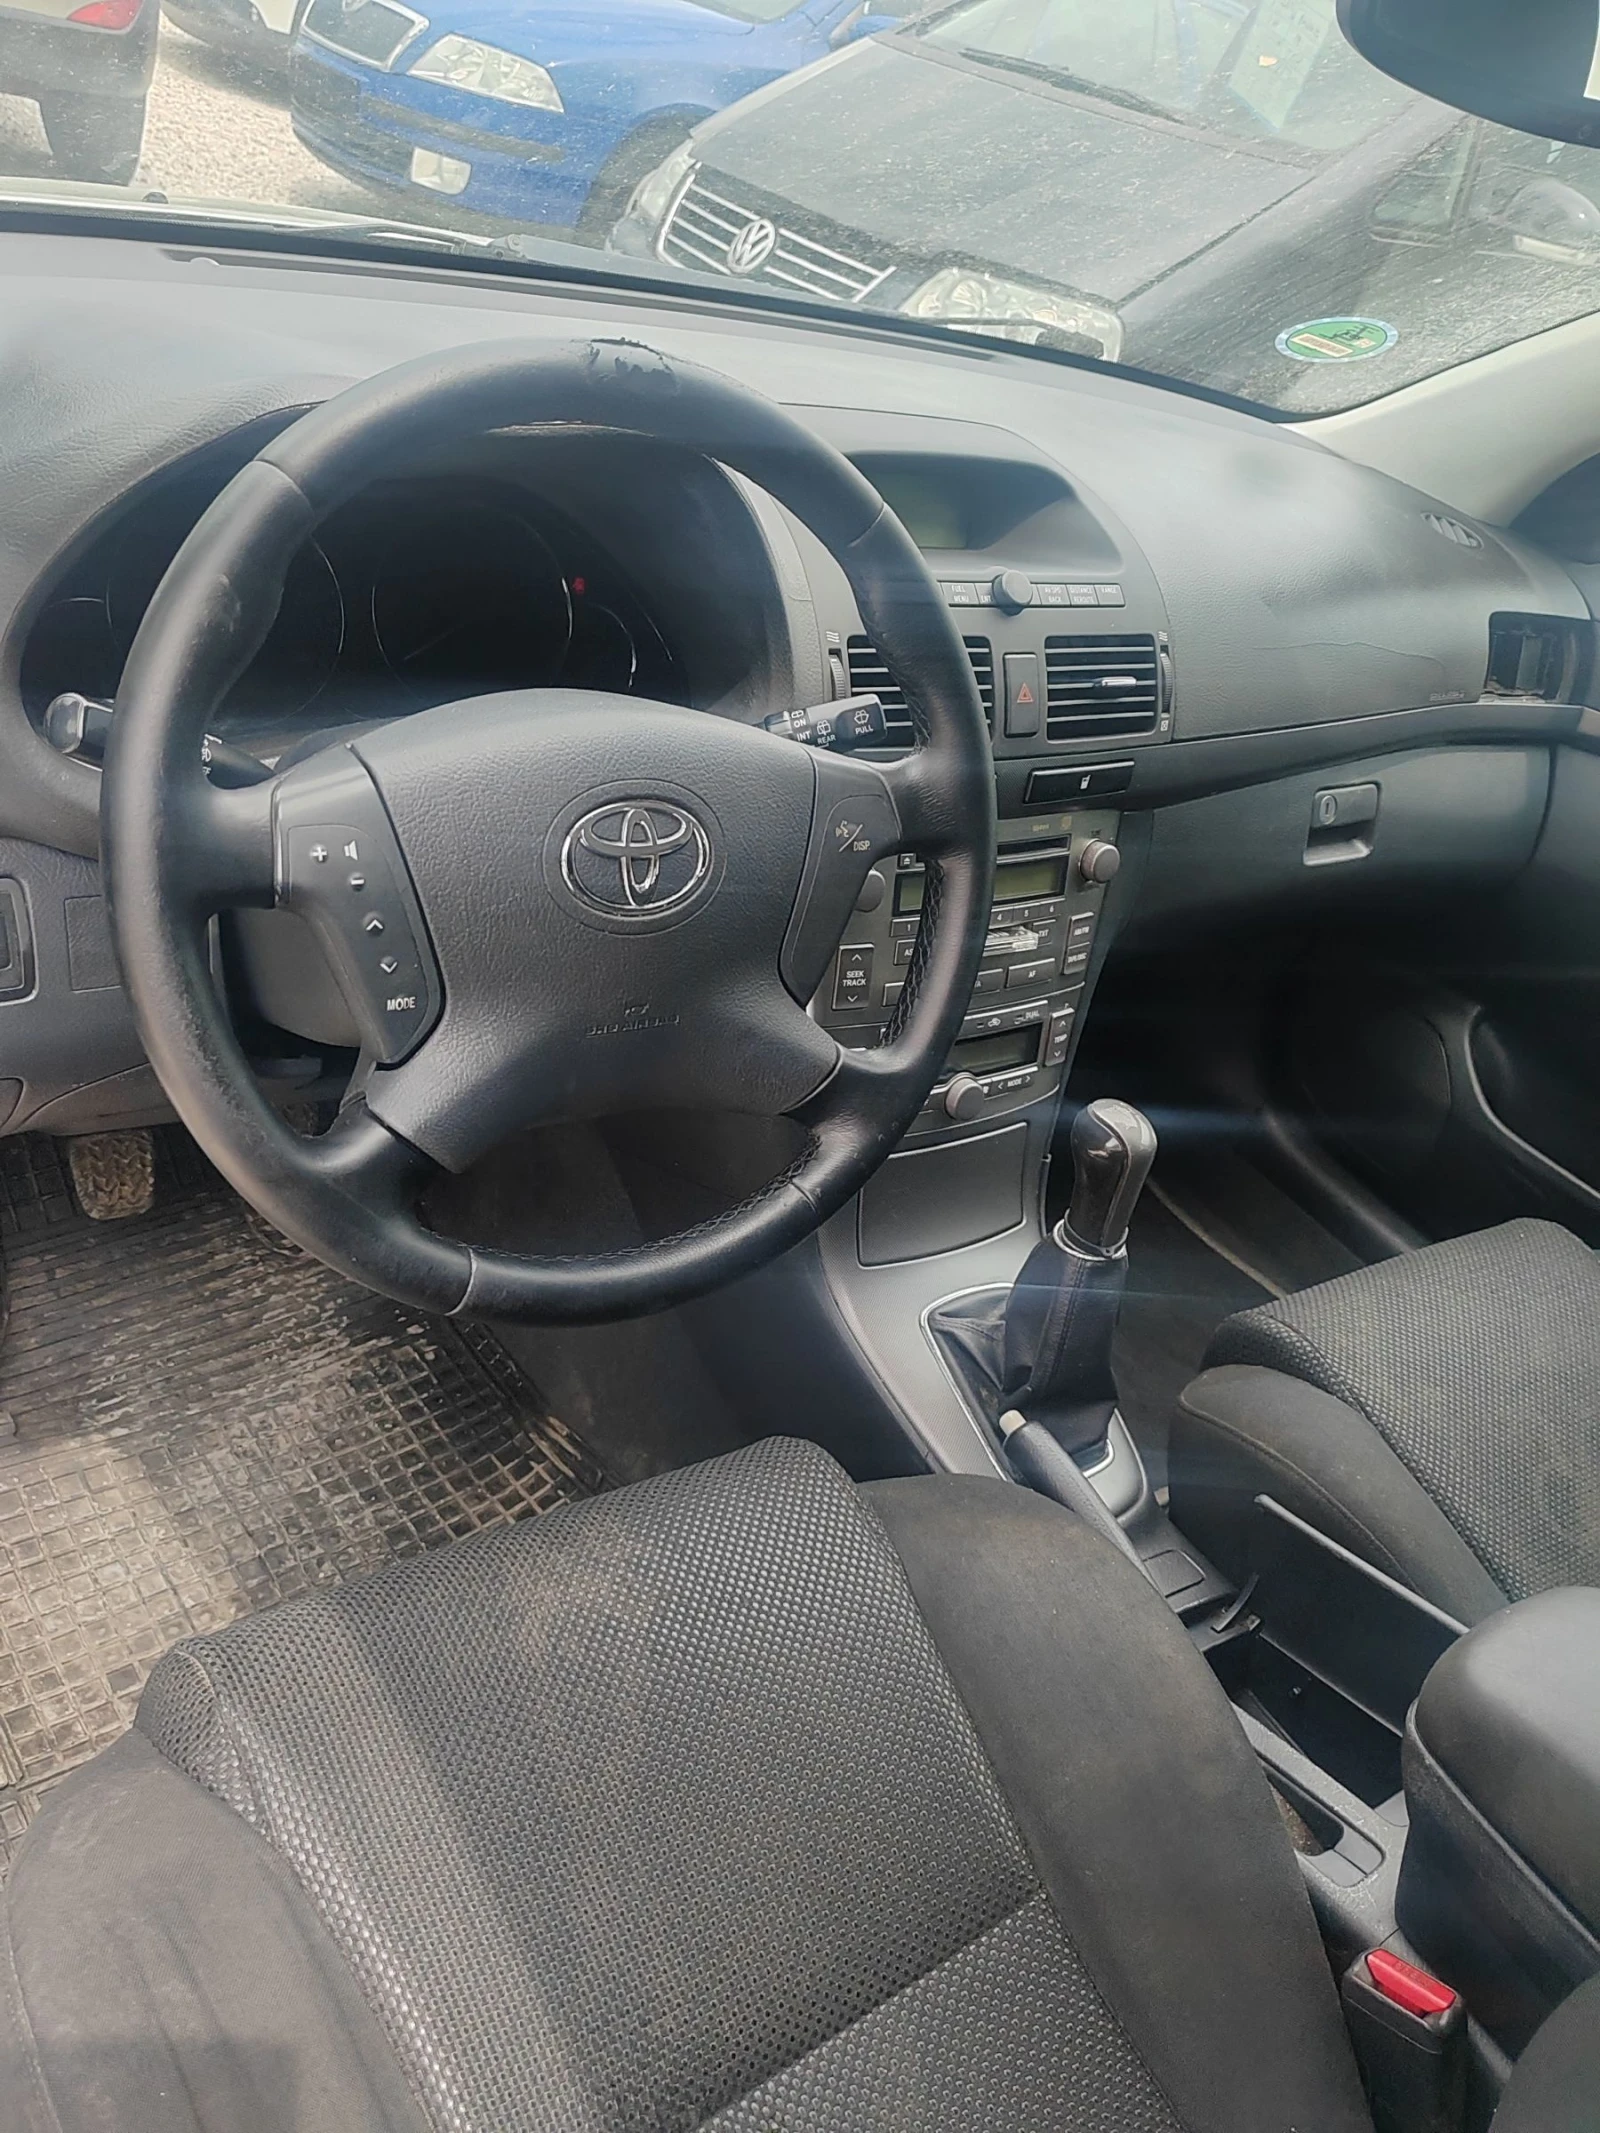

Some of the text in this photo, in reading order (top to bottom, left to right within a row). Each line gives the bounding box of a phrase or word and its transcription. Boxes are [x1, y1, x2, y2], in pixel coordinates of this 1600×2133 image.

[794, 718, 806, 728] ON
[855, 724, 873, 735] PULL
[796, 730, 811, 741] INT
[817, 735, 836, 745] REAR
[1024, 909, 1029, 917] 5
[1049, 905, 1054, 913] 6
[997, 913, 1002, 921] 4
[1038, 929, 1049, 938] TXT
[846, 970, 865, 979] SEEK
[1028, 970, 1037, 978] AF
[842, 978, 867, 987] TRACK
[386, 997, 416, 1011] MODE
[1054, 1033, 1068, 1044] TEMP
[1007, 1078, 1022, 1087] MODE
